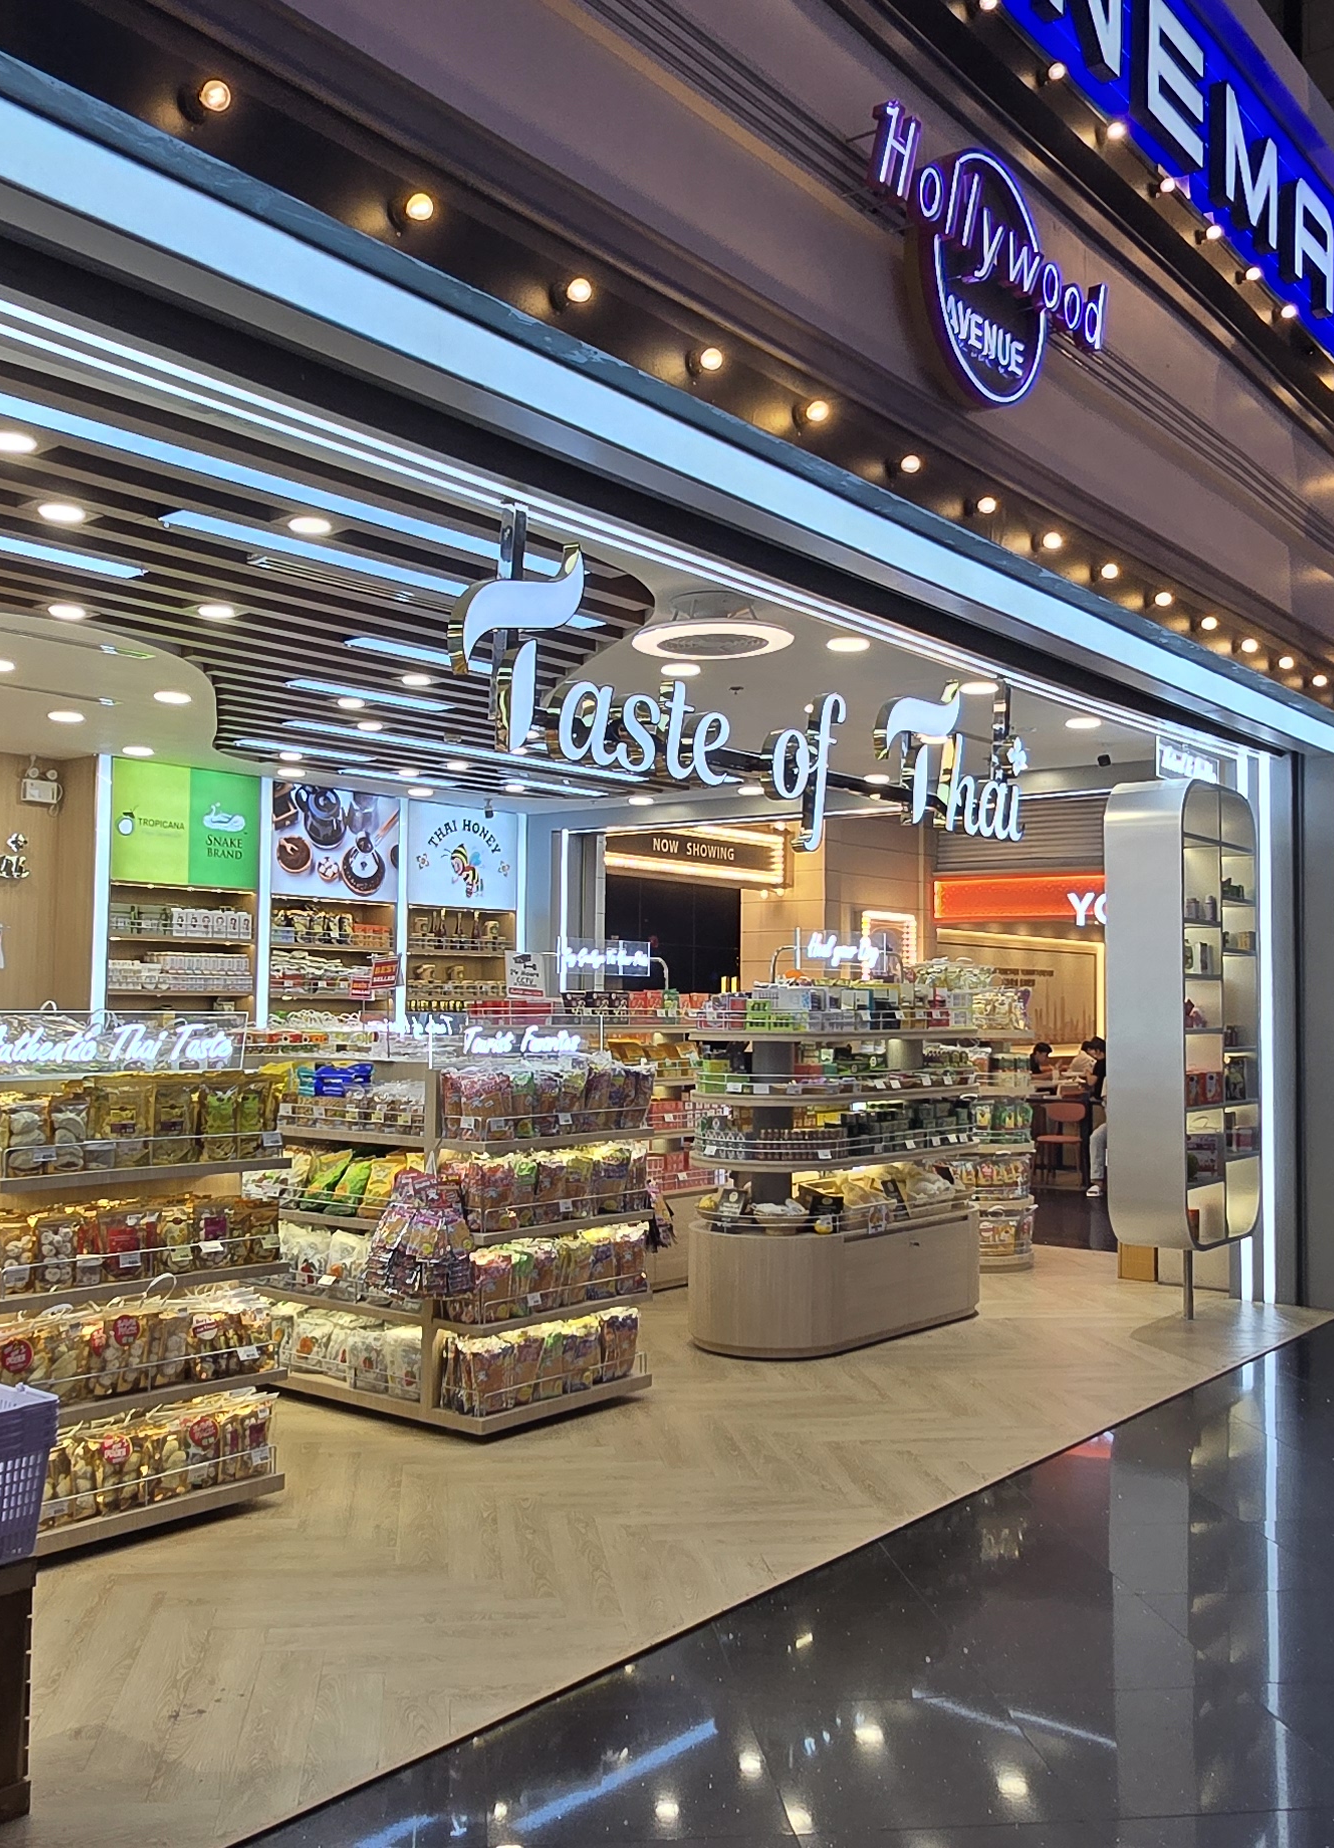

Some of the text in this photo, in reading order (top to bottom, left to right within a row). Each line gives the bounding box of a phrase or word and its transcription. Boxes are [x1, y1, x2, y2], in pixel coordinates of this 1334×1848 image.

[874, 101, 1107, 350] Hollywood
[945, 294, 1025, 378] AVENUE
[448, 543, 1029, 853] Taste of Thai
[138, 817, 185, 831] TROPICANA
[205, 833, 243, 849] SNAKE
[427, 818, 502, 854] THAI HONEY
[206, 848, 243, 860] BRAND
[652, 838, 735, 861] NOW SHOWING
[373, 964, 397, 976] BEST
[516, 976, 534, 984] CCTV
[107, 1023, 165, 1063] Thai
[169, 1023, 234, 1061] Taste
